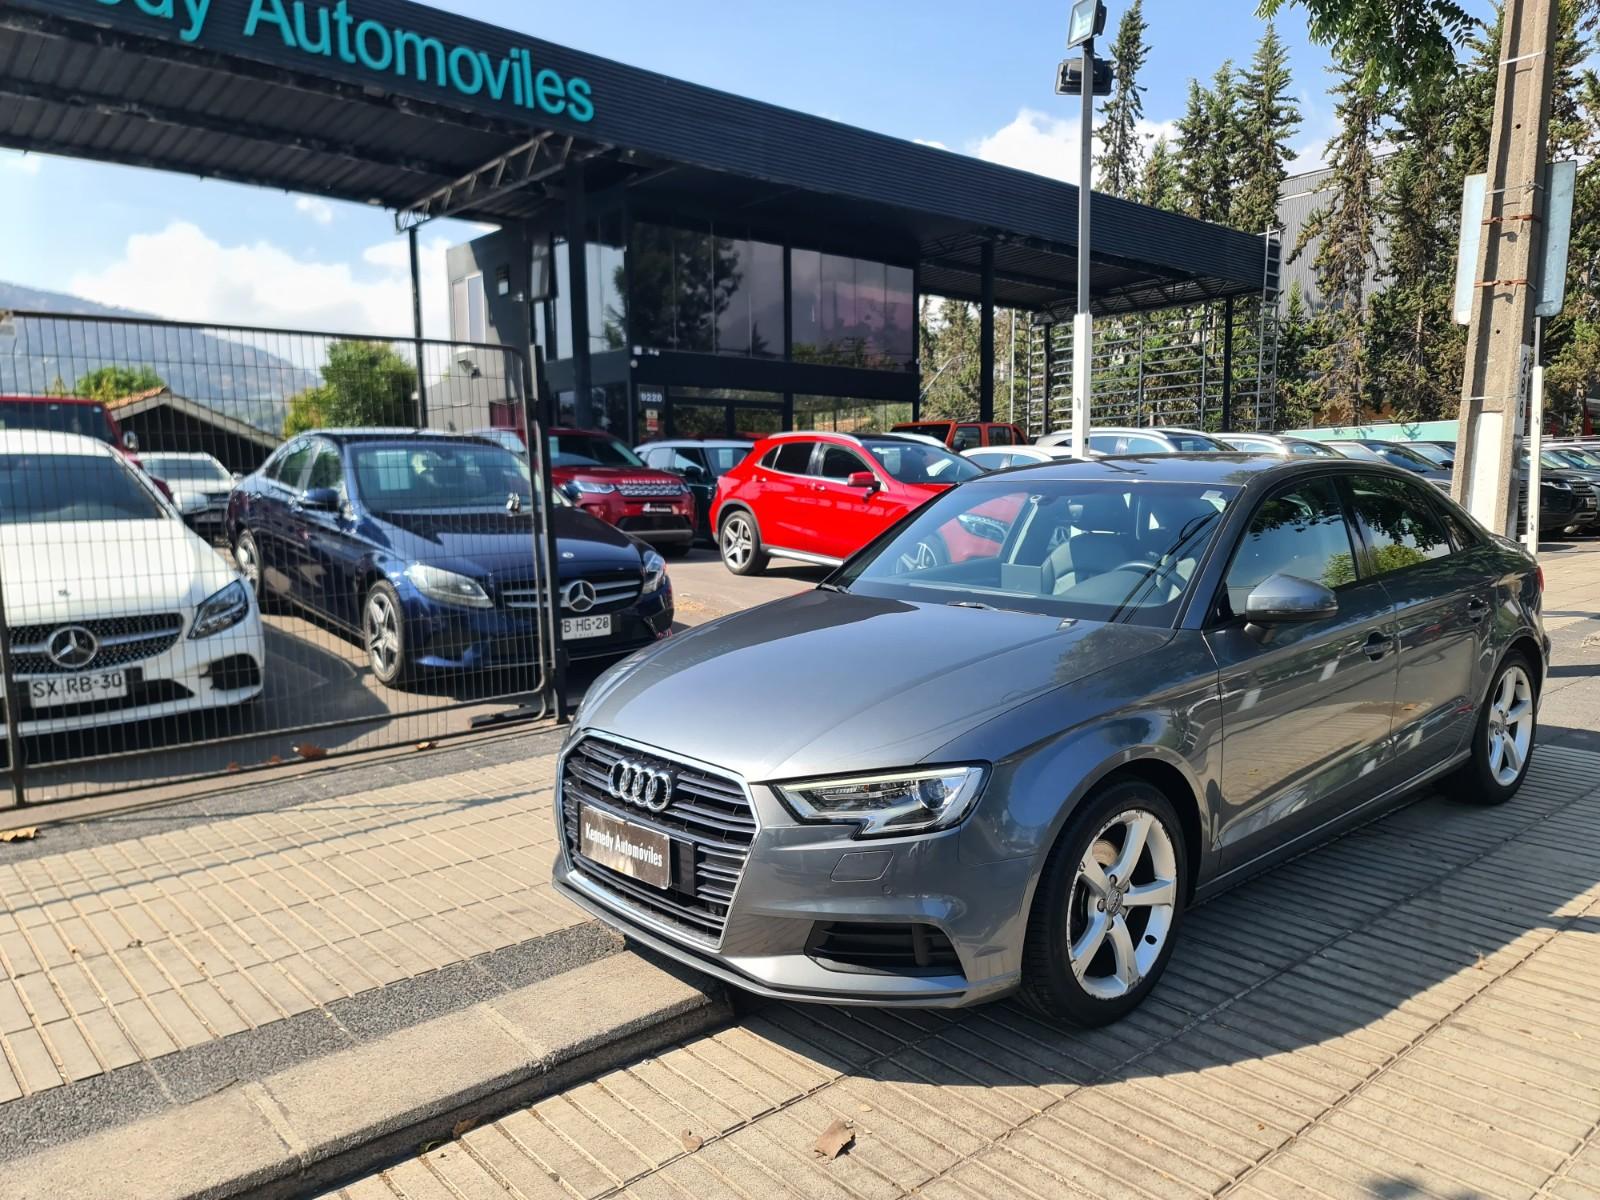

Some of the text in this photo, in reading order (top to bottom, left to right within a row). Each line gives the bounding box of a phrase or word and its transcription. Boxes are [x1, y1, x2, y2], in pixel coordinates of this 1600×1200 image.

[243, 0, 595, 122] Automoviles
[585, 822, 663, 867] Kennedy Automóviles
